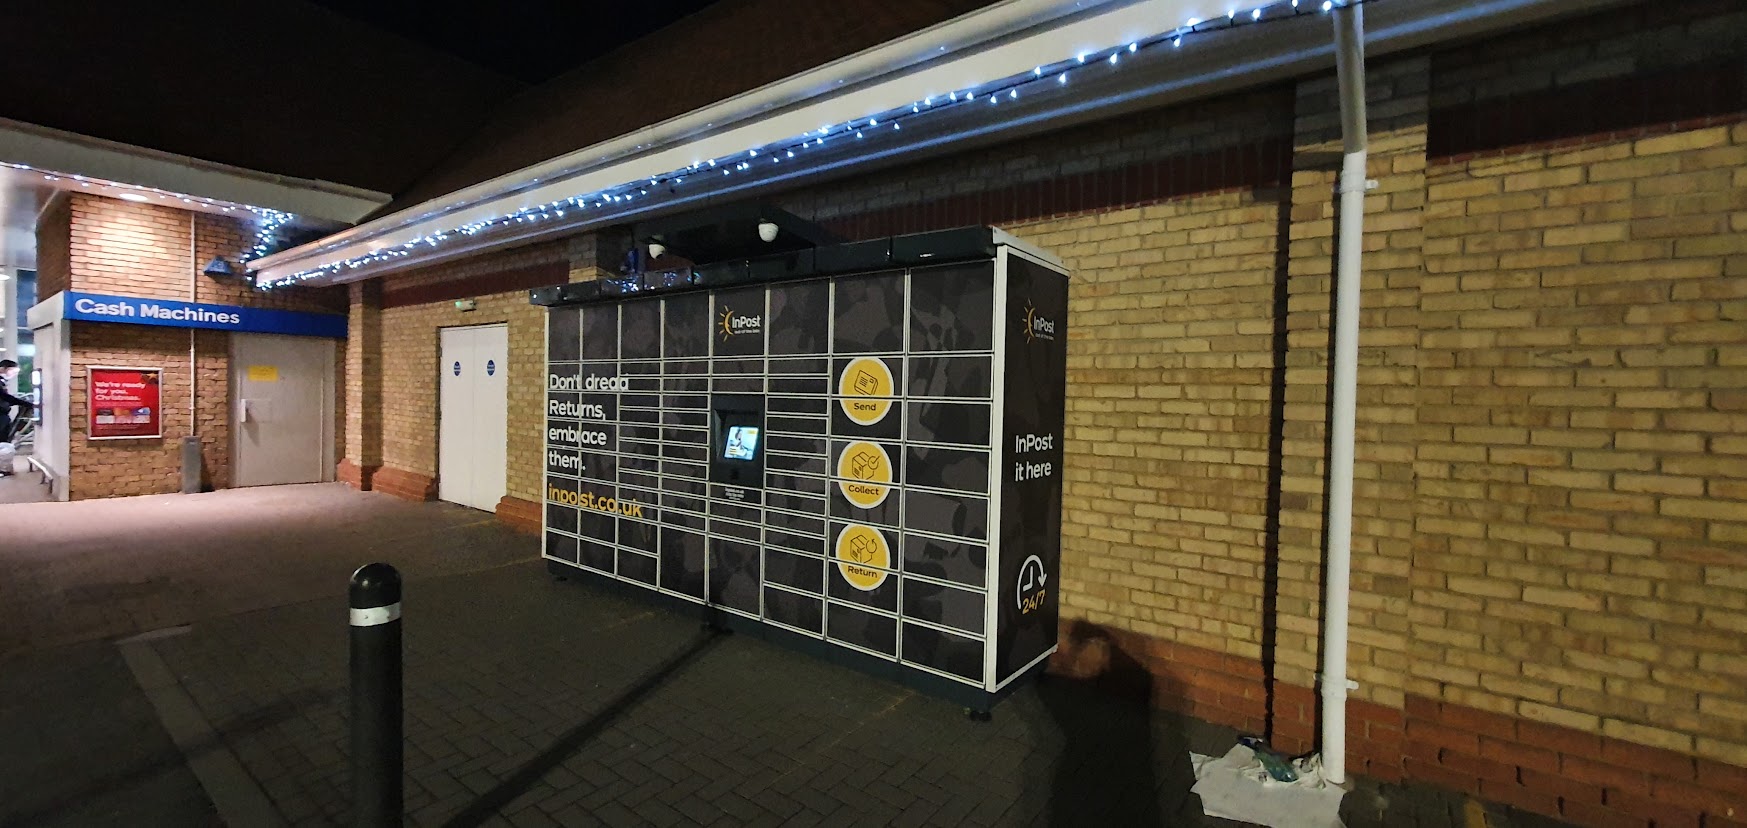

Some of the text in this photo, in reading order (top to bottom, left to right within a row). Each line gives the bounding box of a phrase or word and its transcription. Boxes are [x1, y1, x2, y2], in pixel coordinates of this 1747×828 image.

[75, 298, 240, 324] Cash Machines
[731, 314, 761, 329] InPost
[1033, 315, 1055, 334] InPost
[549, 373, 580, 390] Don't
[549, 399, 606, 421] Returns,
[853, 402, 876, 411] Send
[548, 425, 607, 446] embrace
[1015, 433, 1053, 454] InPost
[548, 450, 586, 471] them.
[1015, 461, 1052, 482] it here
[548, 483, 643, 518] inpost.co.uk
[848, 484, 880, 496] Collect
[847, 565, 878, 579] Return
[1022, 589, 1046, 615] 24/7
